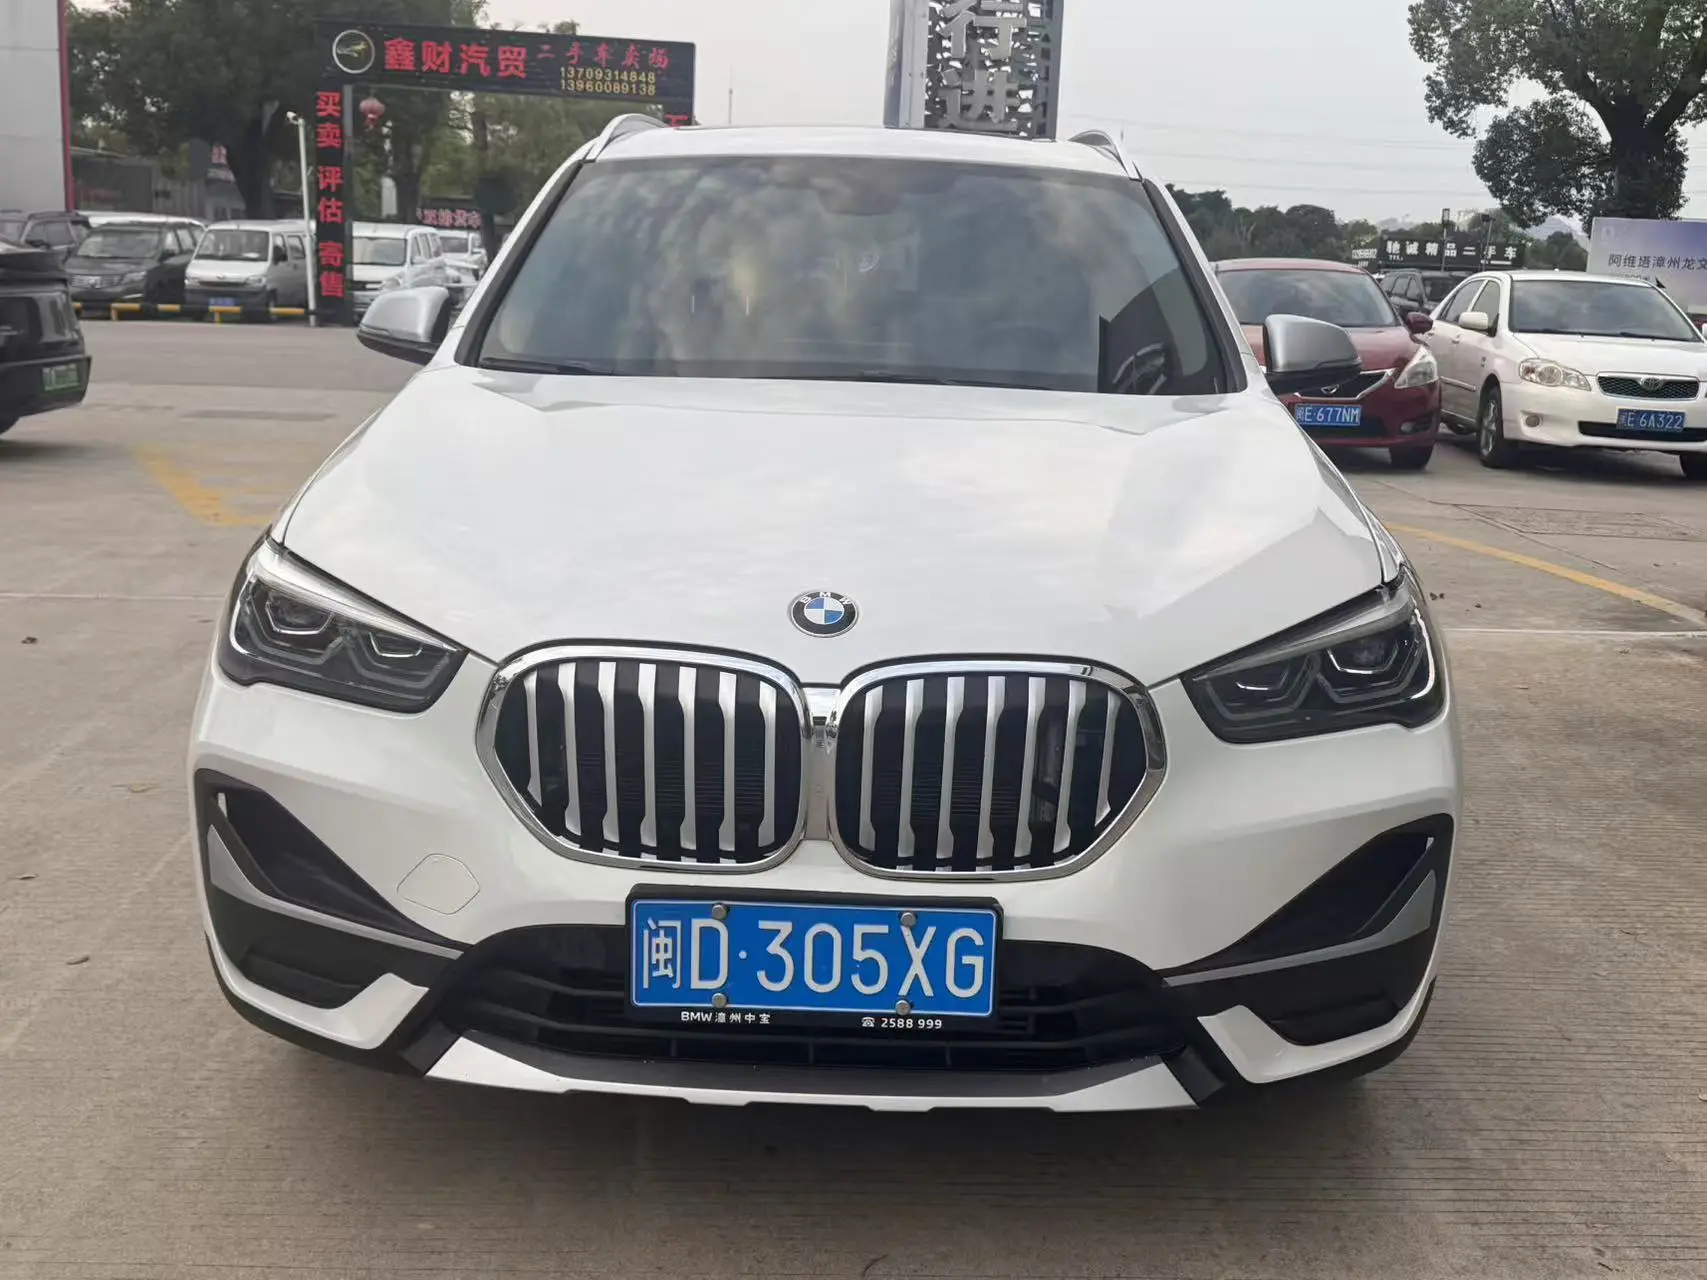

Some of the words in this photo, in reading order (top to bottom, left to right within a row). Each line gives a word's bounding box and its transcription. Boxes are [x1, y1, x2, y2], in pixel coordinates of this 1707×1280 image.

[383, 37, 528, 79] 鑫财汽贸
[560, 79, 656, 96] 13960089138
[881, 1018, 913, 1028] 2588
[918, 1019, 942, 1029] 999
